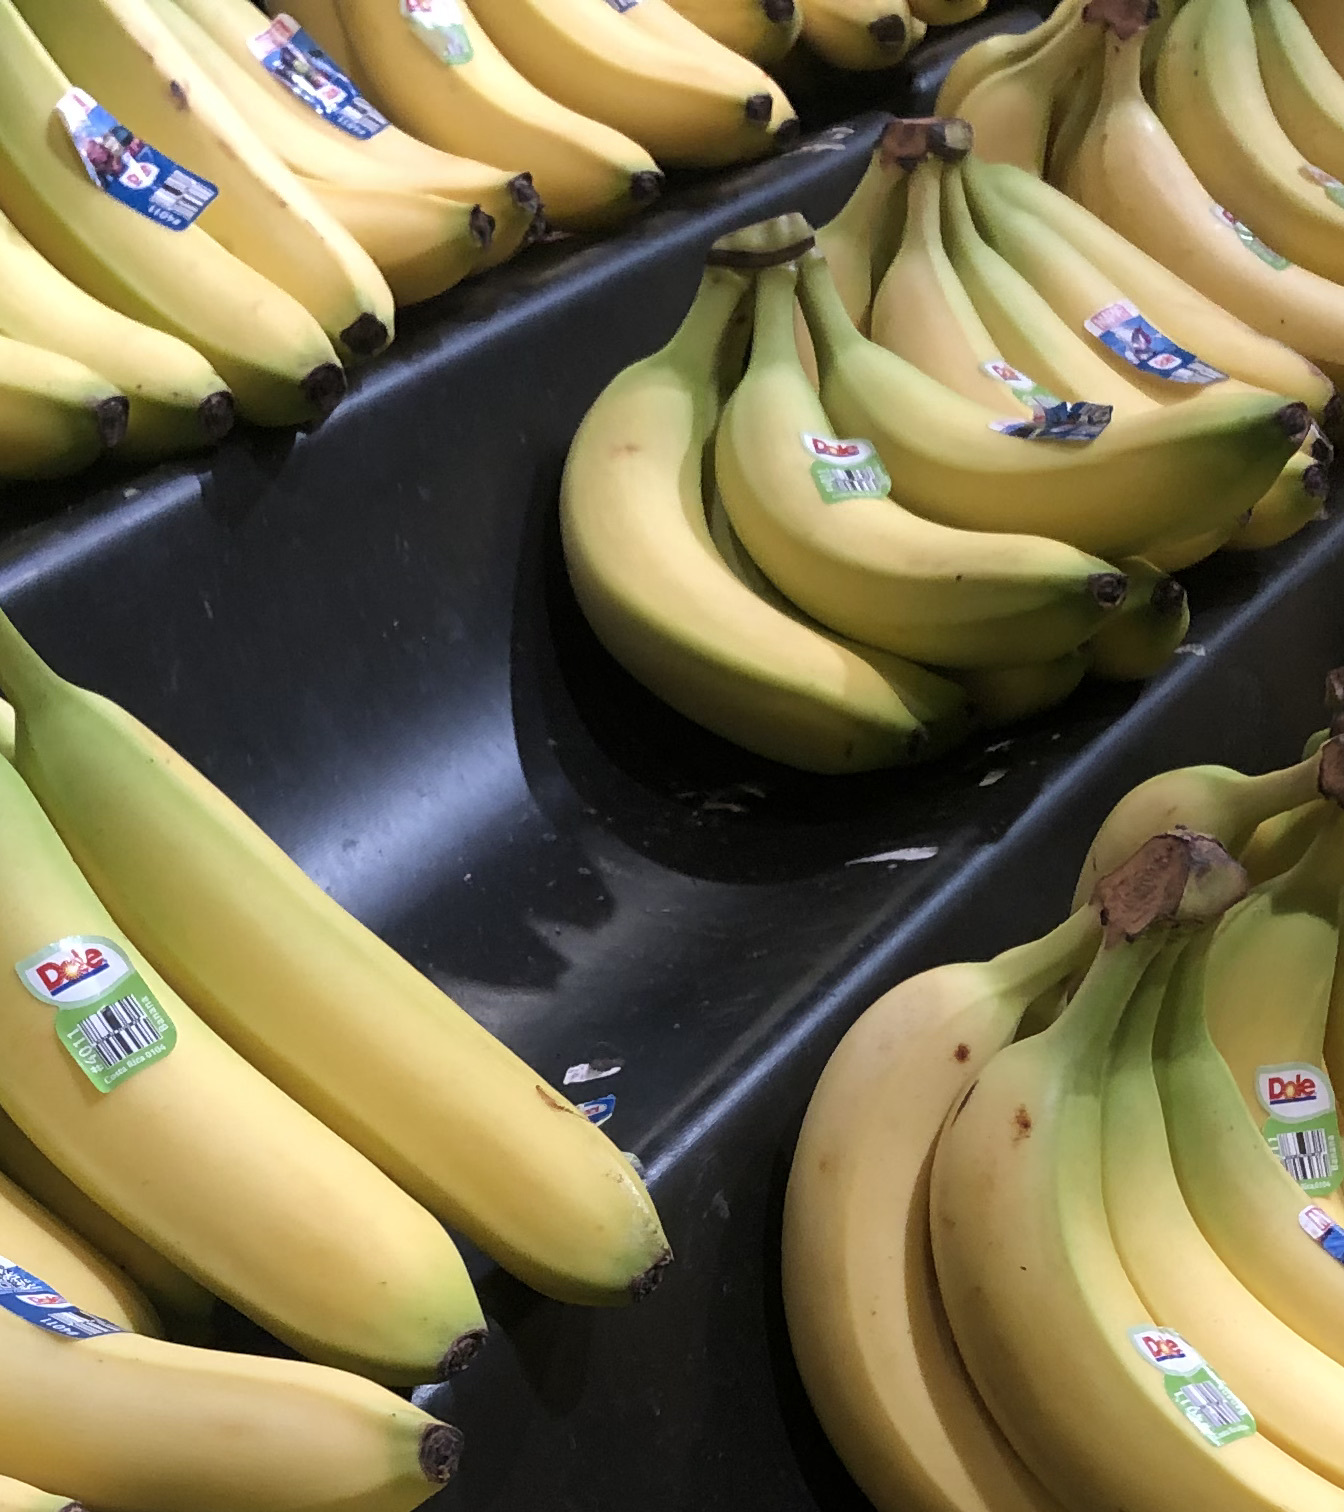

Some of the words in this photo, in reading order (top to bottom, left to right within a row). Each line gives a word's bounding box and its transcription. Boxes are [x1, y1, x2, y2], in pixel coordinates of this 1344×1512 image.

[36, 948, 104, 991] Dole
[141, 996, 169, 1033] Banana
[67, 1027, 104, 1074] #4011
[104, 1067, 128, 1084] Costa
[126, 1055, 146, 1068] Rica
[1269, 1074, 1316, 1100] Dole
